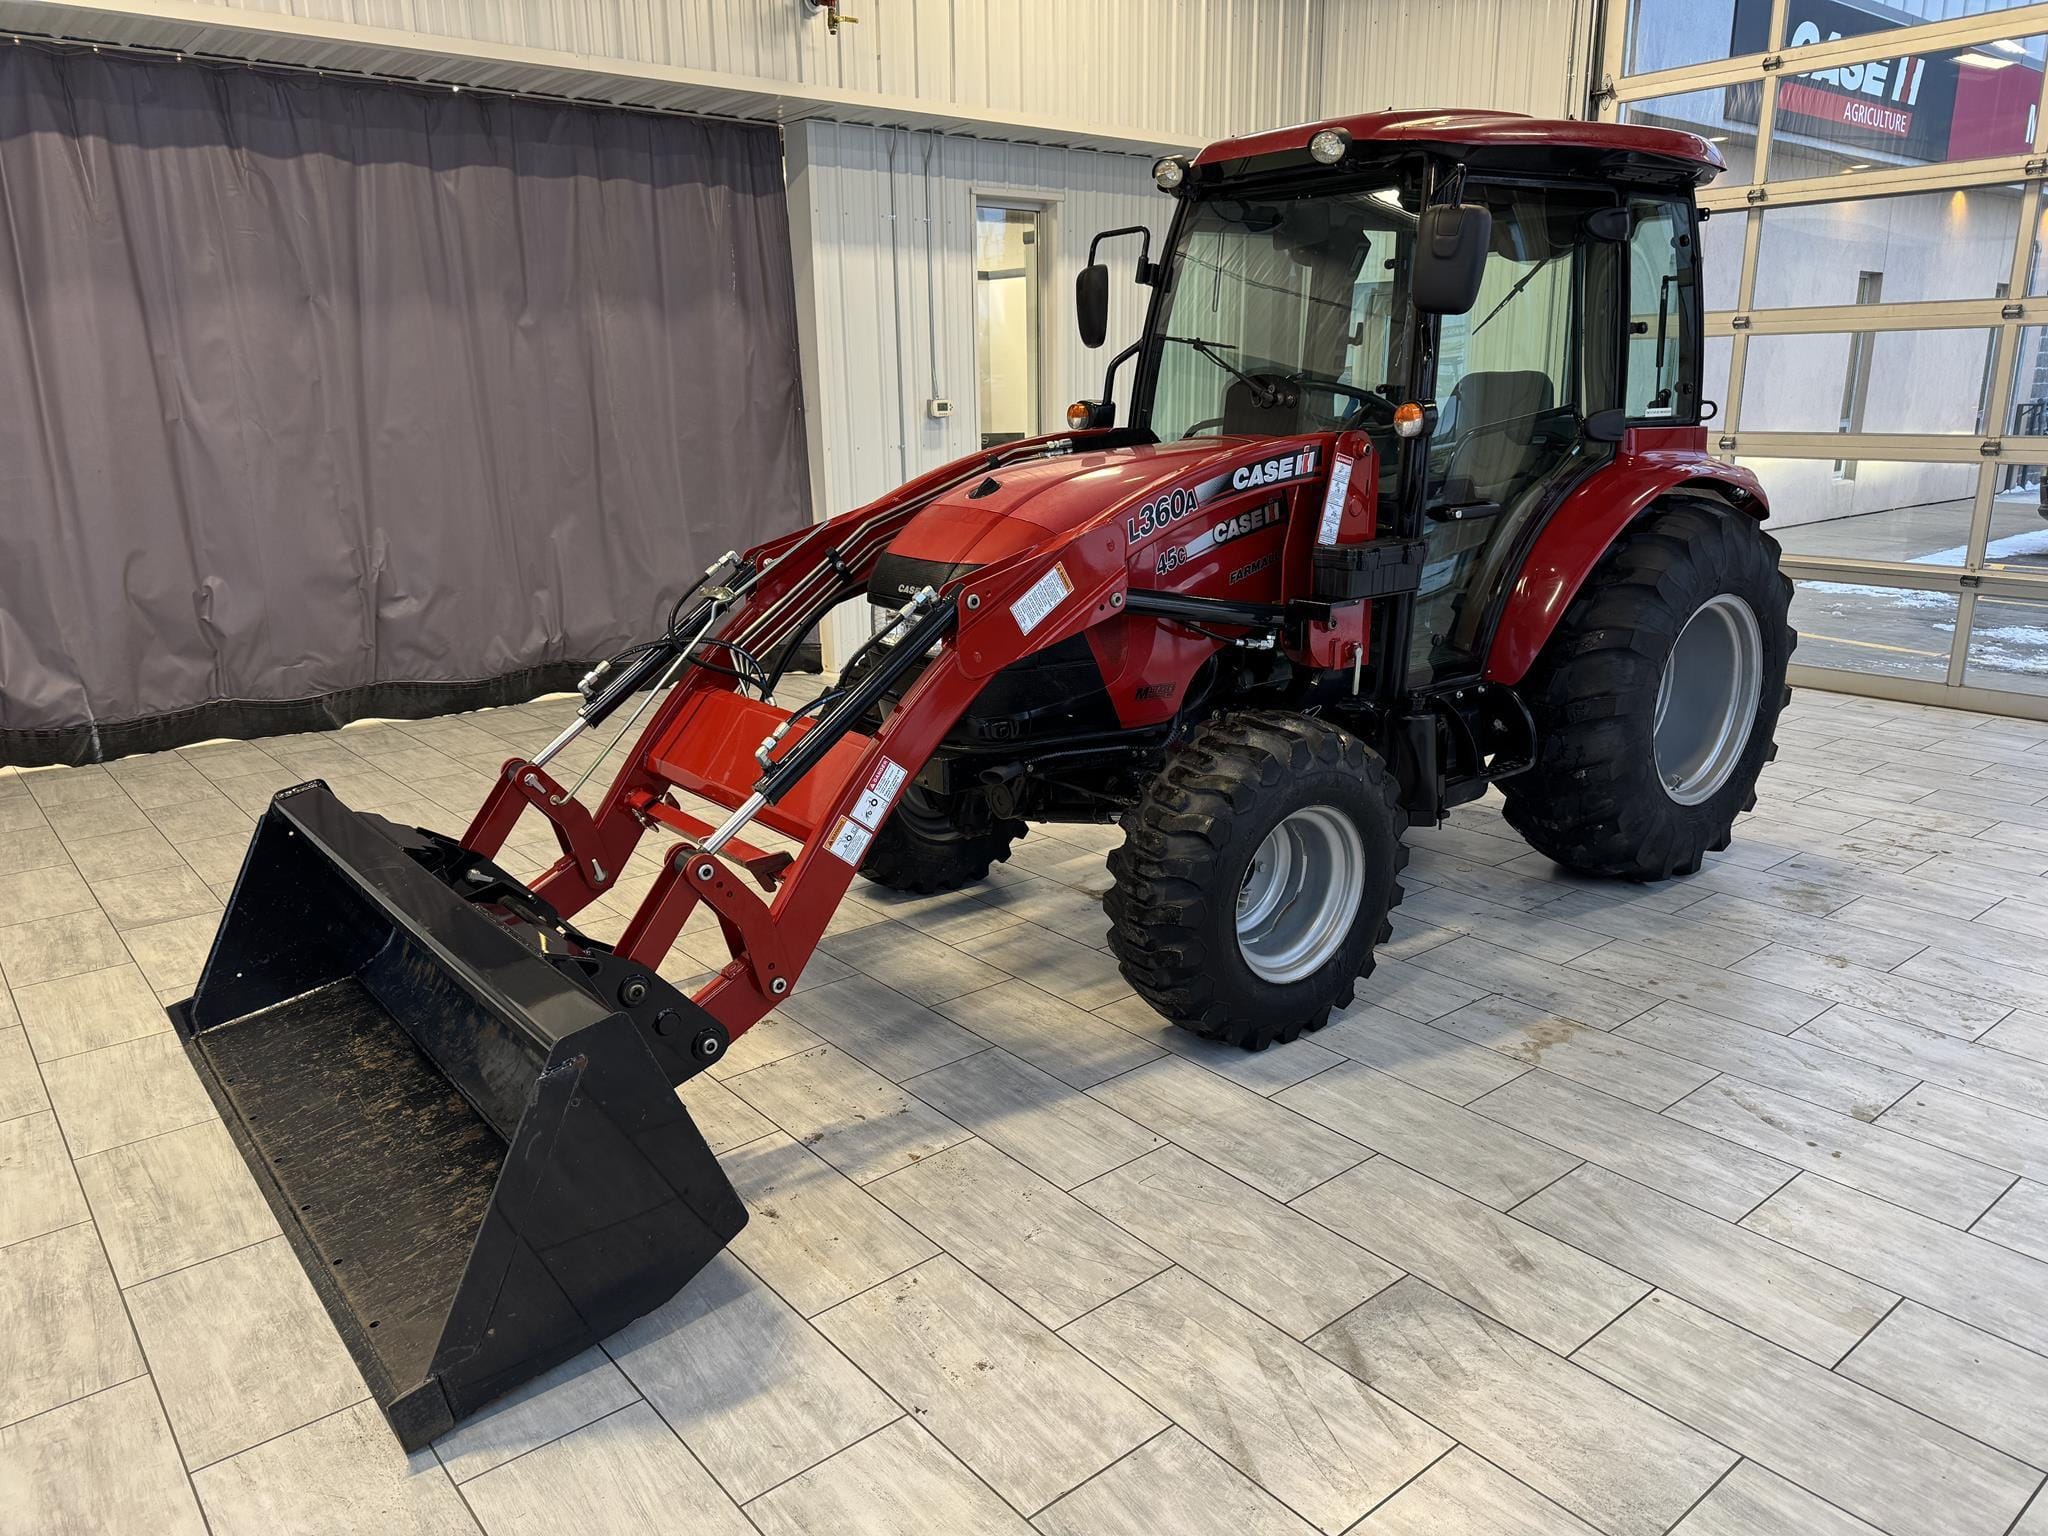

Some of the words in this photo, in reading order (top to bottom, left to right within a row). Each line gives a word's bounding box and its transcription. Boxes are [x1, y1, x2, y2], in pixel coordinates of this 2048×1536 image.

[1843, 102, 1907, 133] AGRICULTURE
[1232, 457, 1294, 492] CASE
[1128, 487, 1199, 544] L360A
[1212, 511, 1263, 544] CASE
[1156, 546, 1188, 577] 45C
